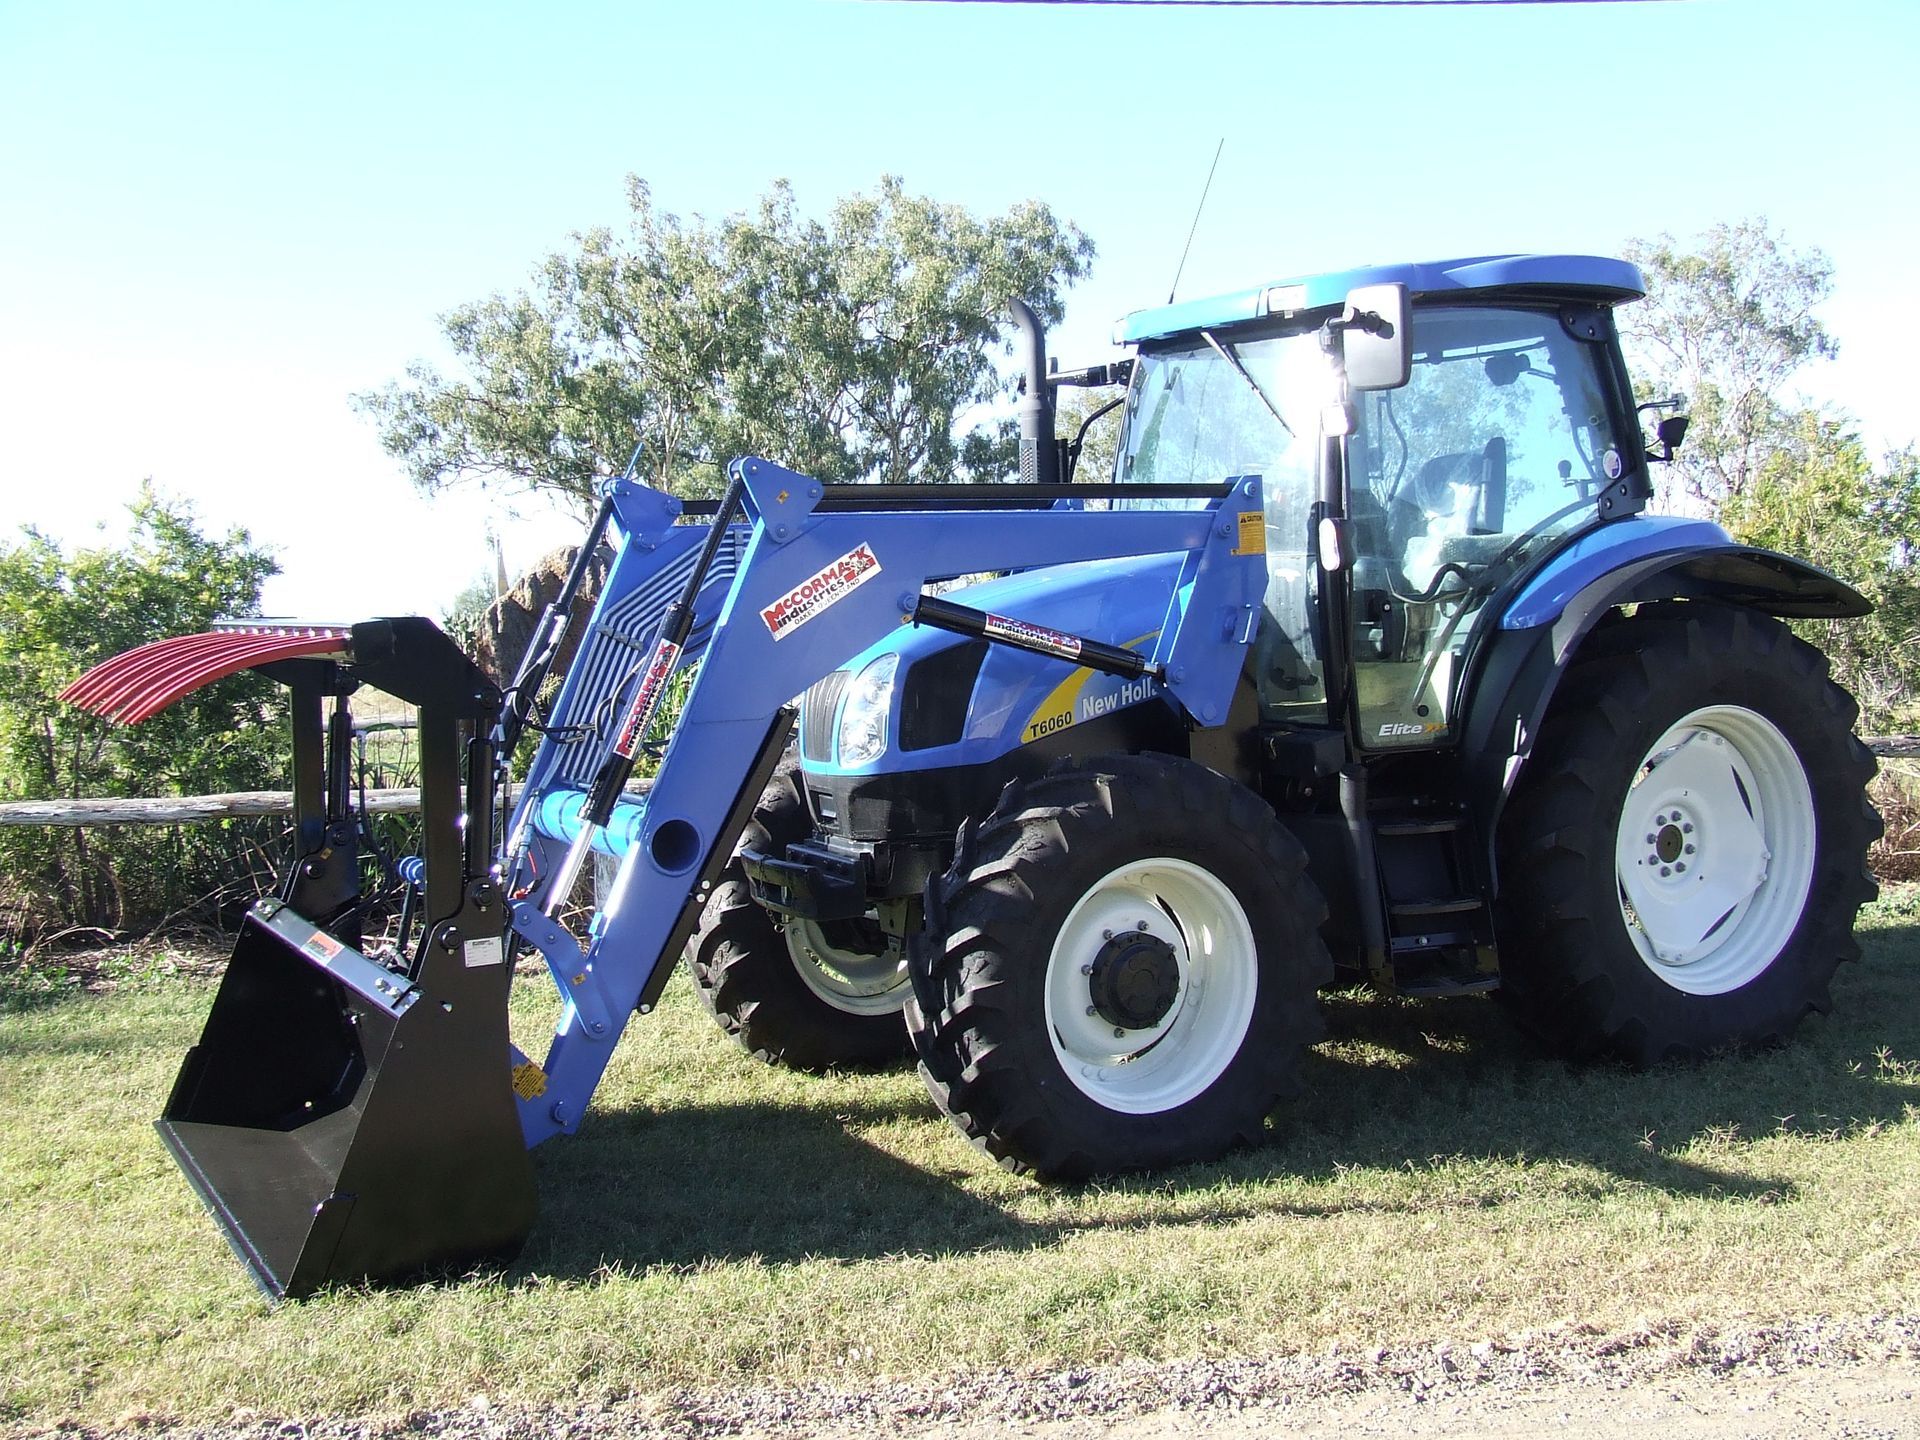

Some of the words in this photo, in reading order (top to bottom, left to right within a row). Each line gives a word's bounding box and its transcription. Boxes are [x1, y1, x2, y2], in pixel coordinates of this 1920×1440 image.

[777, 578, 845, 628] industries
[993, 621, 1053, 643] industries
[1082, 692, 1117, 719] New
[1030, 711, 1072, 738] T6060
[1379, 723, 1422, 736] Elite
